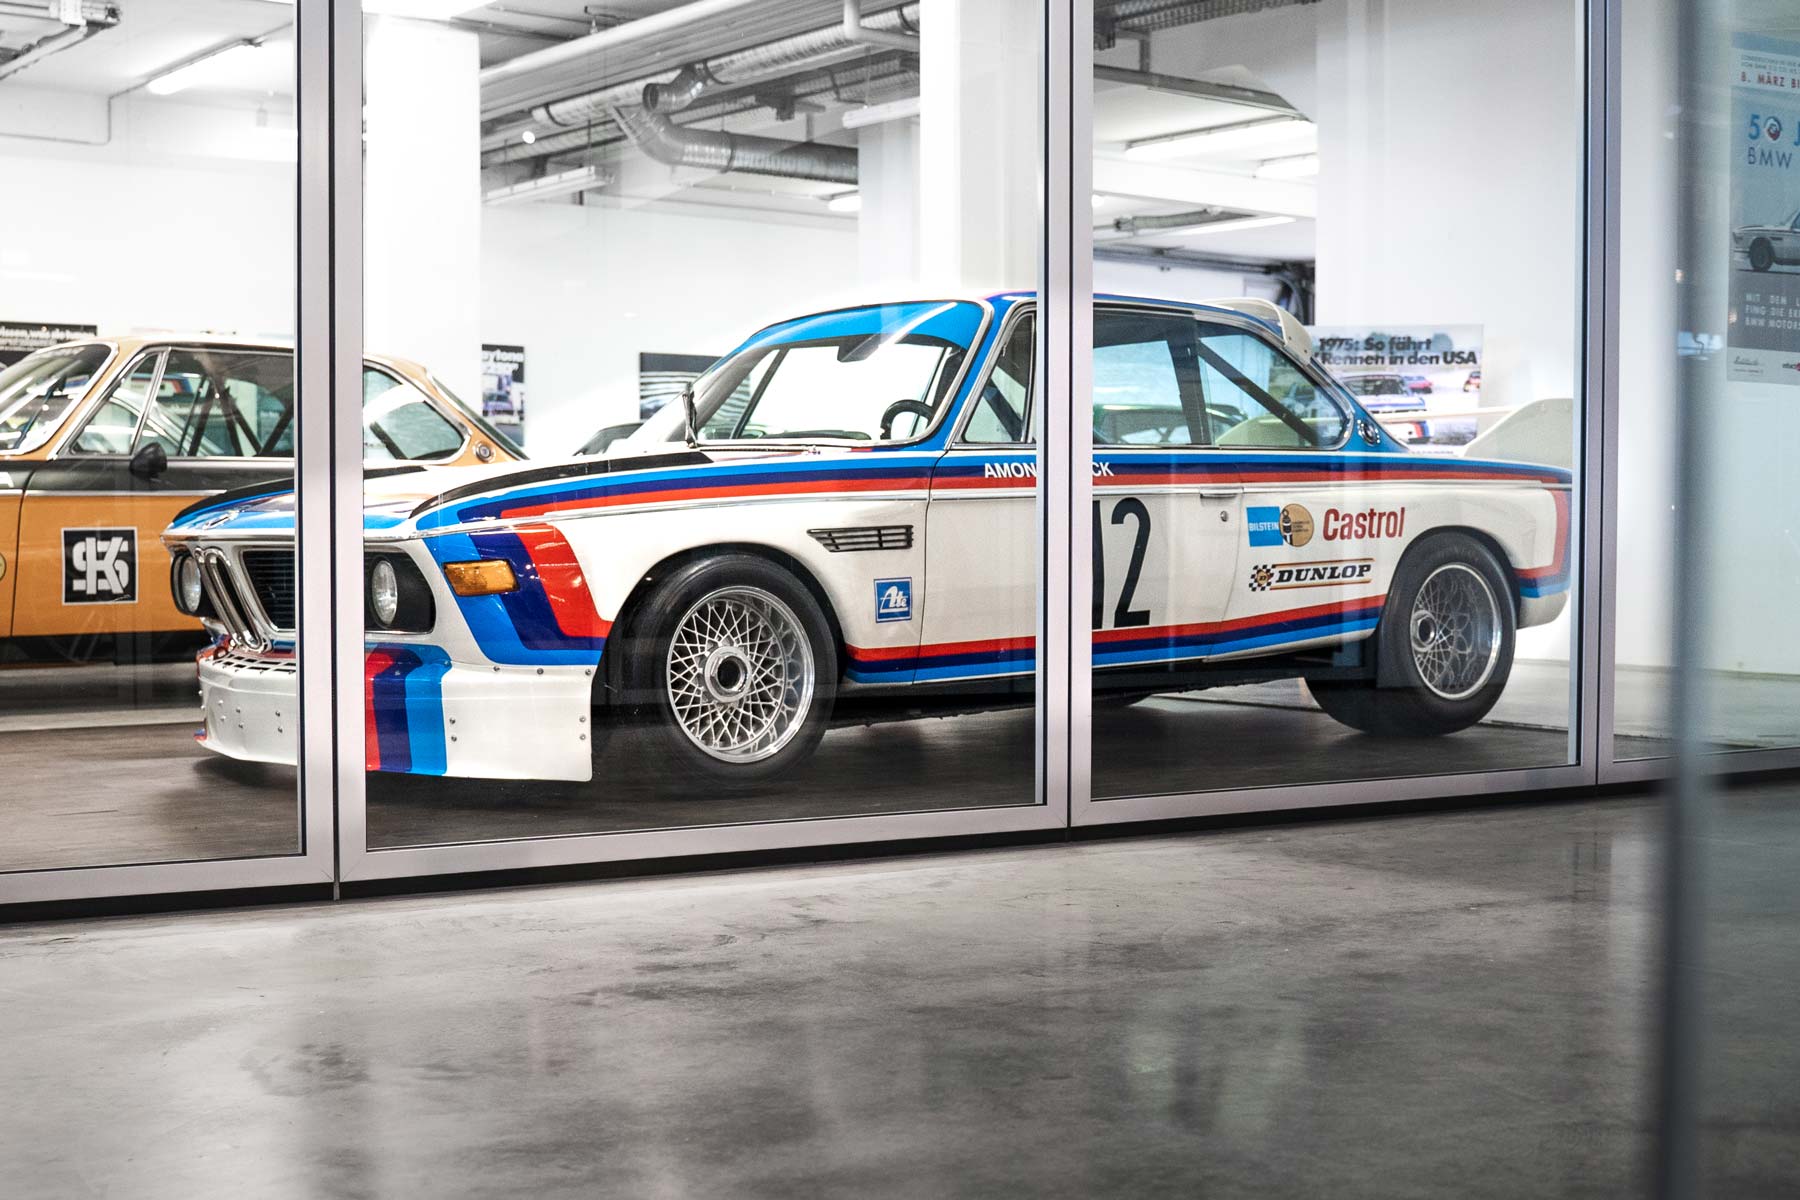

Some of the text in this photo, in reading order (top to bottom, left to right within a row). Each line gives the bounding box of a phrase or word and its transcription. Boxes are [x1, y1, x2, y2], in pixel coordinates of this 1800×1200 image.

[1757, 71, 1785, 88] MÄRZ
[1747, 146, 1793, 169] BMW
[1319, 336, 1432, 351] 1975: So fährt
[1321, 352, 1385, 366] Rennen
[1389, 352, 1403, 366] in
[1407, 351, 1440, 366] den
[1443, 351, 1478, 366] USA
[1248, 521, 1279, 532] BILSTEIN
[1322, 506, 1406, 541] Castrol
[1276, 564, 1371, 583] DUNLOP
